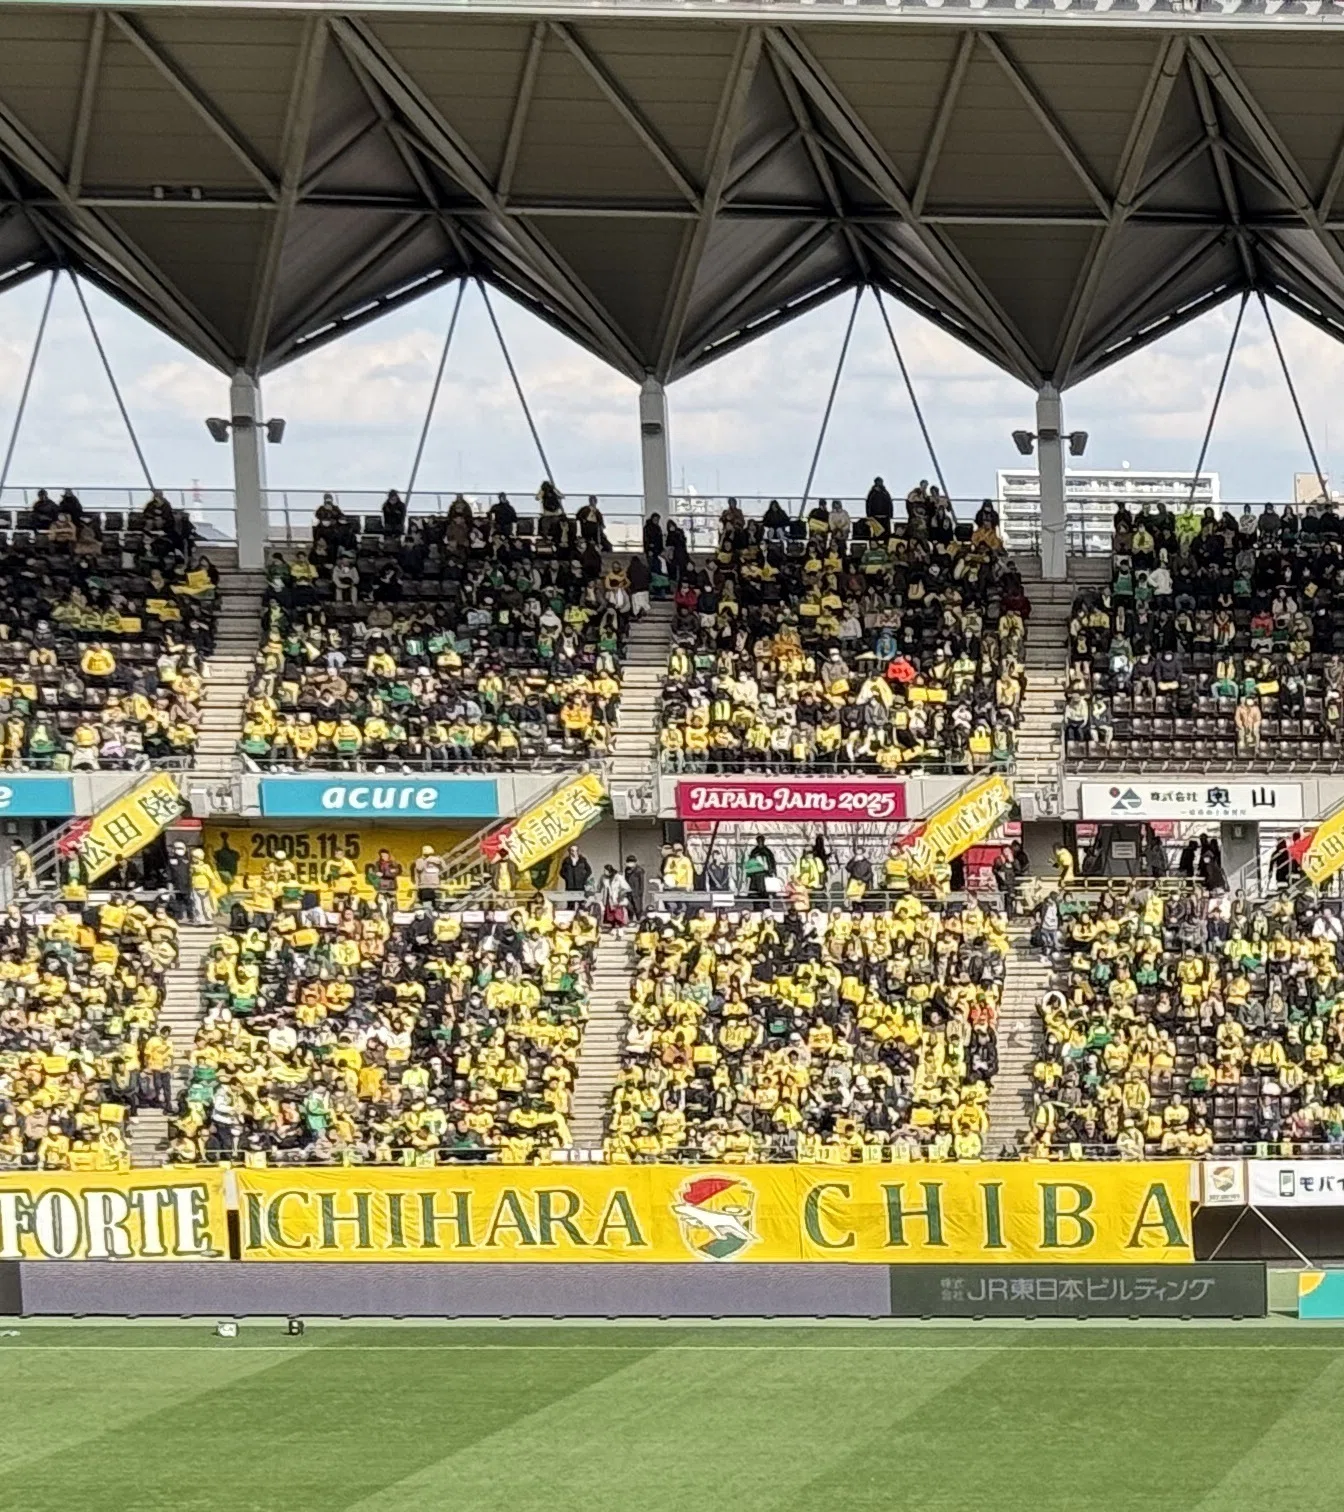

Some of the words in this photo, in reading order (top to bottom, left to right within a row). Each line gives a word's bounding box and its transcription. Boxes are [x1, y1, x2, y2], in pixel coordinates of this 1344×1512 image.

[320, 785, 439, 810] acure
[838, 790, 897, 818] 2025
[250, 831, 361, 861] 2005.115
[244, 1188, 650, 1250] ICHIHARA
[803, 1180, 1191, 1249] CHIBA
[967, 1277, 1216, 1302] JR東日本ビルディング
